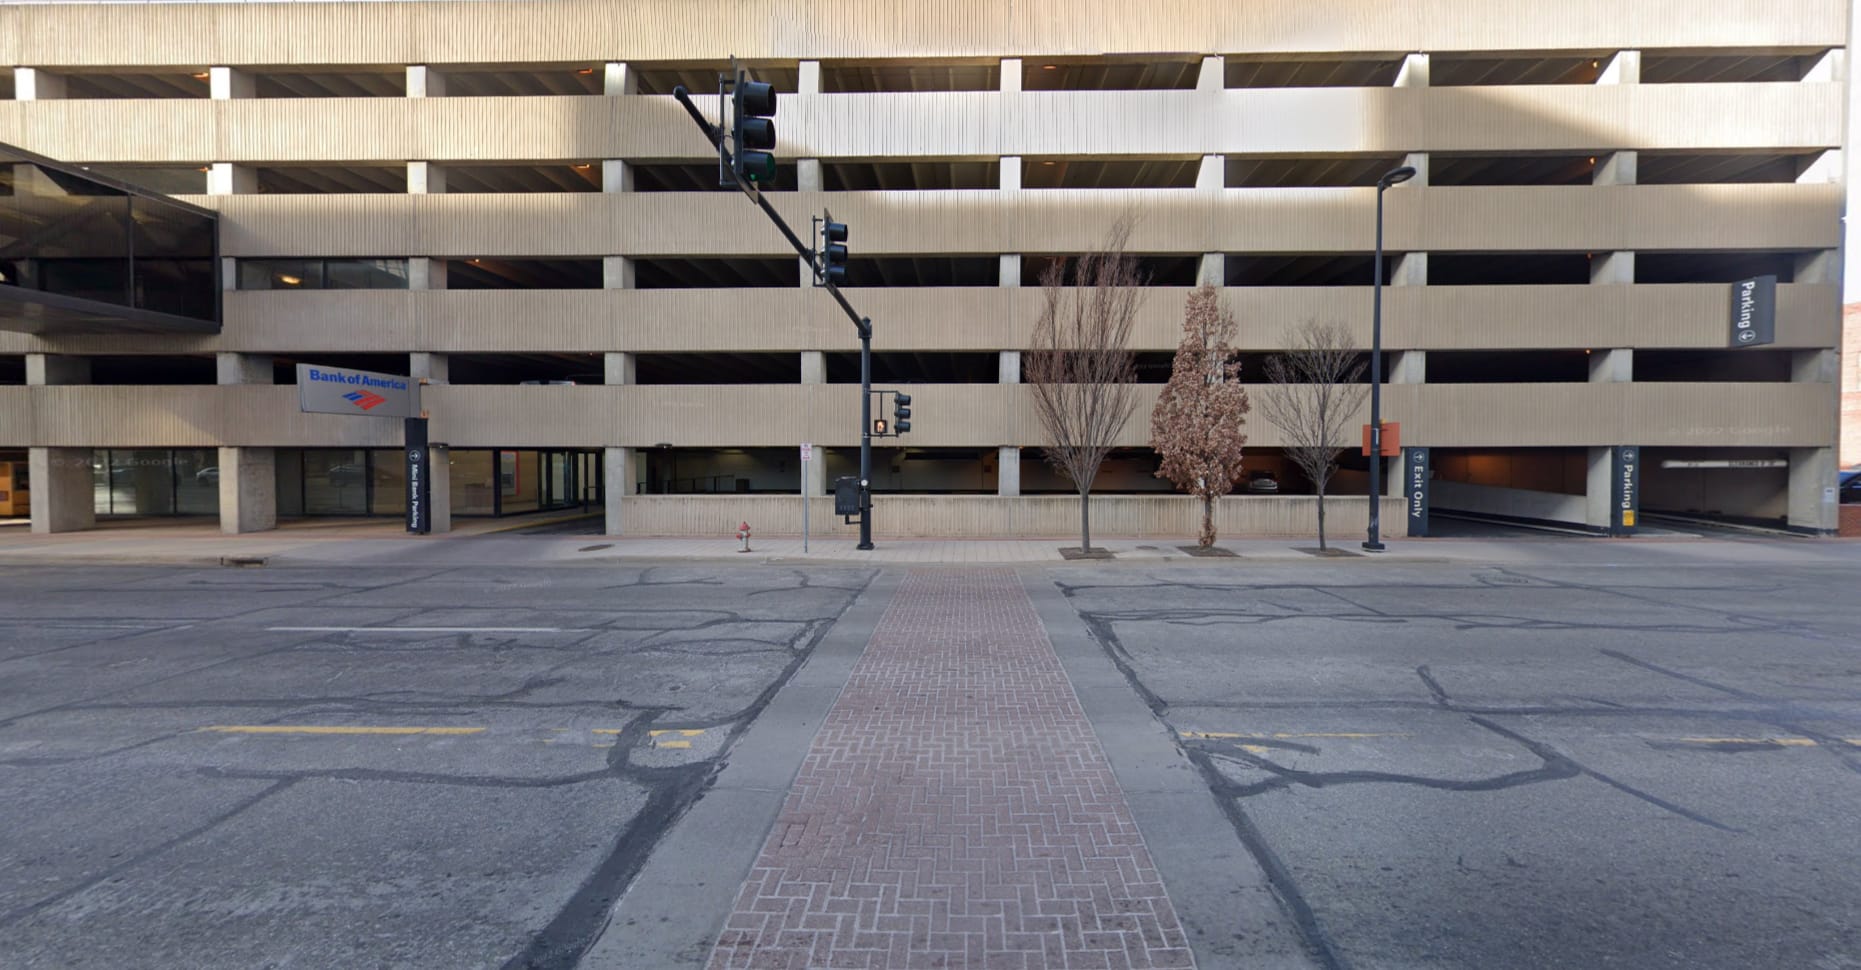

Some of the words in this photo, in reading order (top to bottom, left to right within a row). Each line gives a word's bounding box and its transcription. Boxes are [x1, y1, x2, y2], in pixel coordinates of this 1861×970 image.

[1737, 281, 1756, 329] Parking
[309, 368, 346, 384] Bank
[347, 373, 361, 385] of
[362, 375, 407, 391] America
[1413, 465, 1424, 488] Exit
[1621, 464, 1634, 509] Parking
[411, 481, 419, 500] Bank
[410, 501, 419, 528] Parking
[1412, 491, 1424, 518] Only
